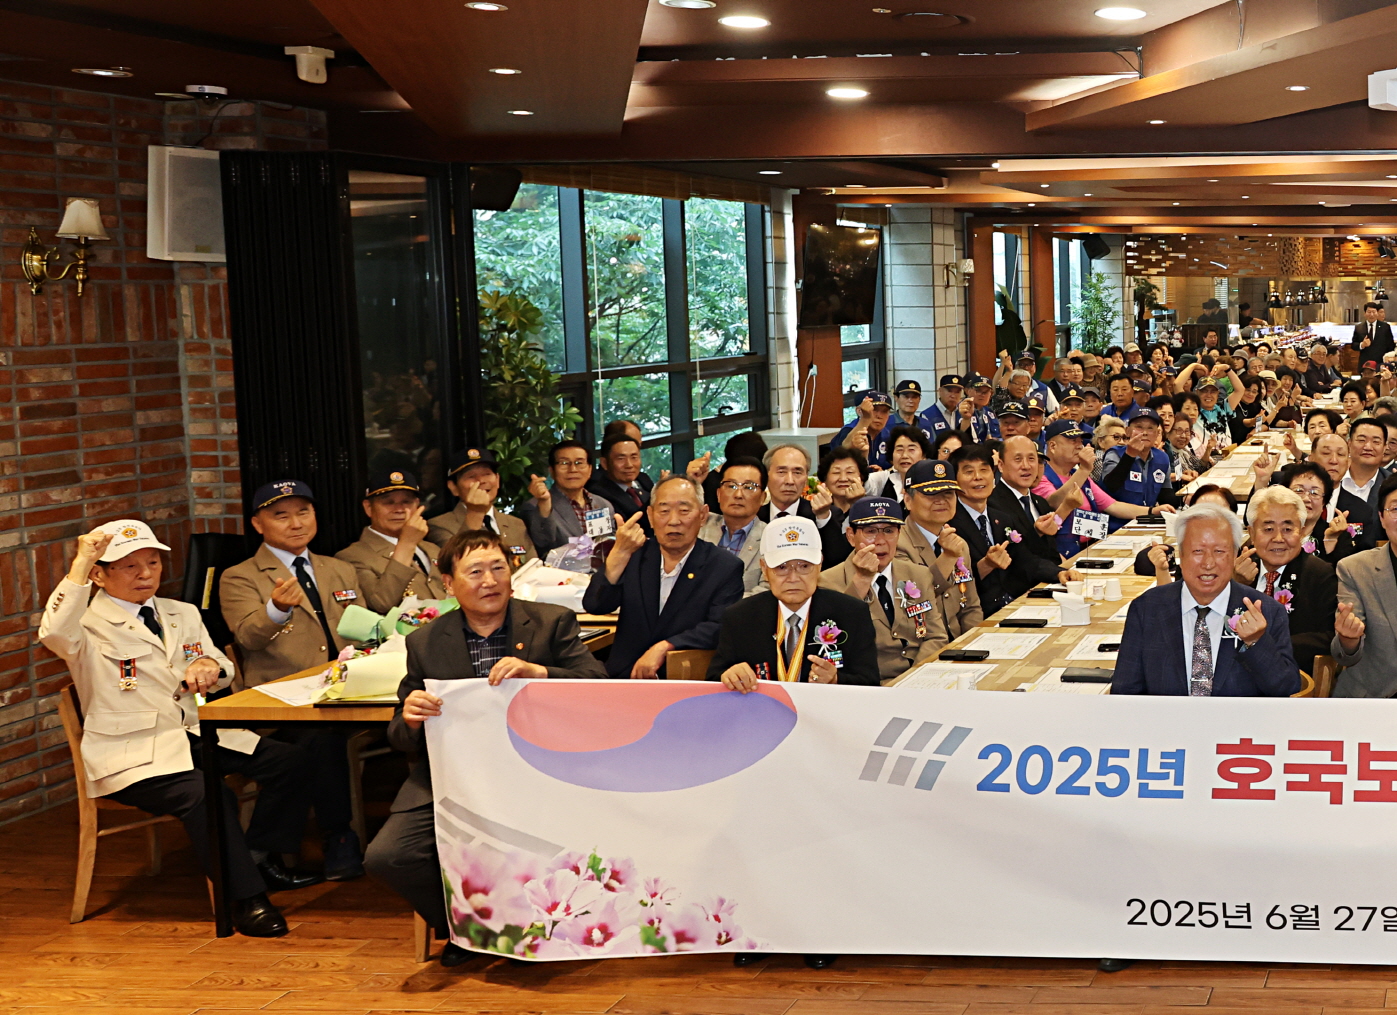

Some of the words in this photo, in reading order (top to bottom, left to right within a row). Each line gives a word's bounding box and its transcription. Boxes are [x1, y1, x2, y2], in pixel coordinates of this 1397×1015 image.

[976, 743, 1187, 800] 2025년
[1126, 898, 1253, 930] 2025년
[1265, 904, 1321, 931] 6월
